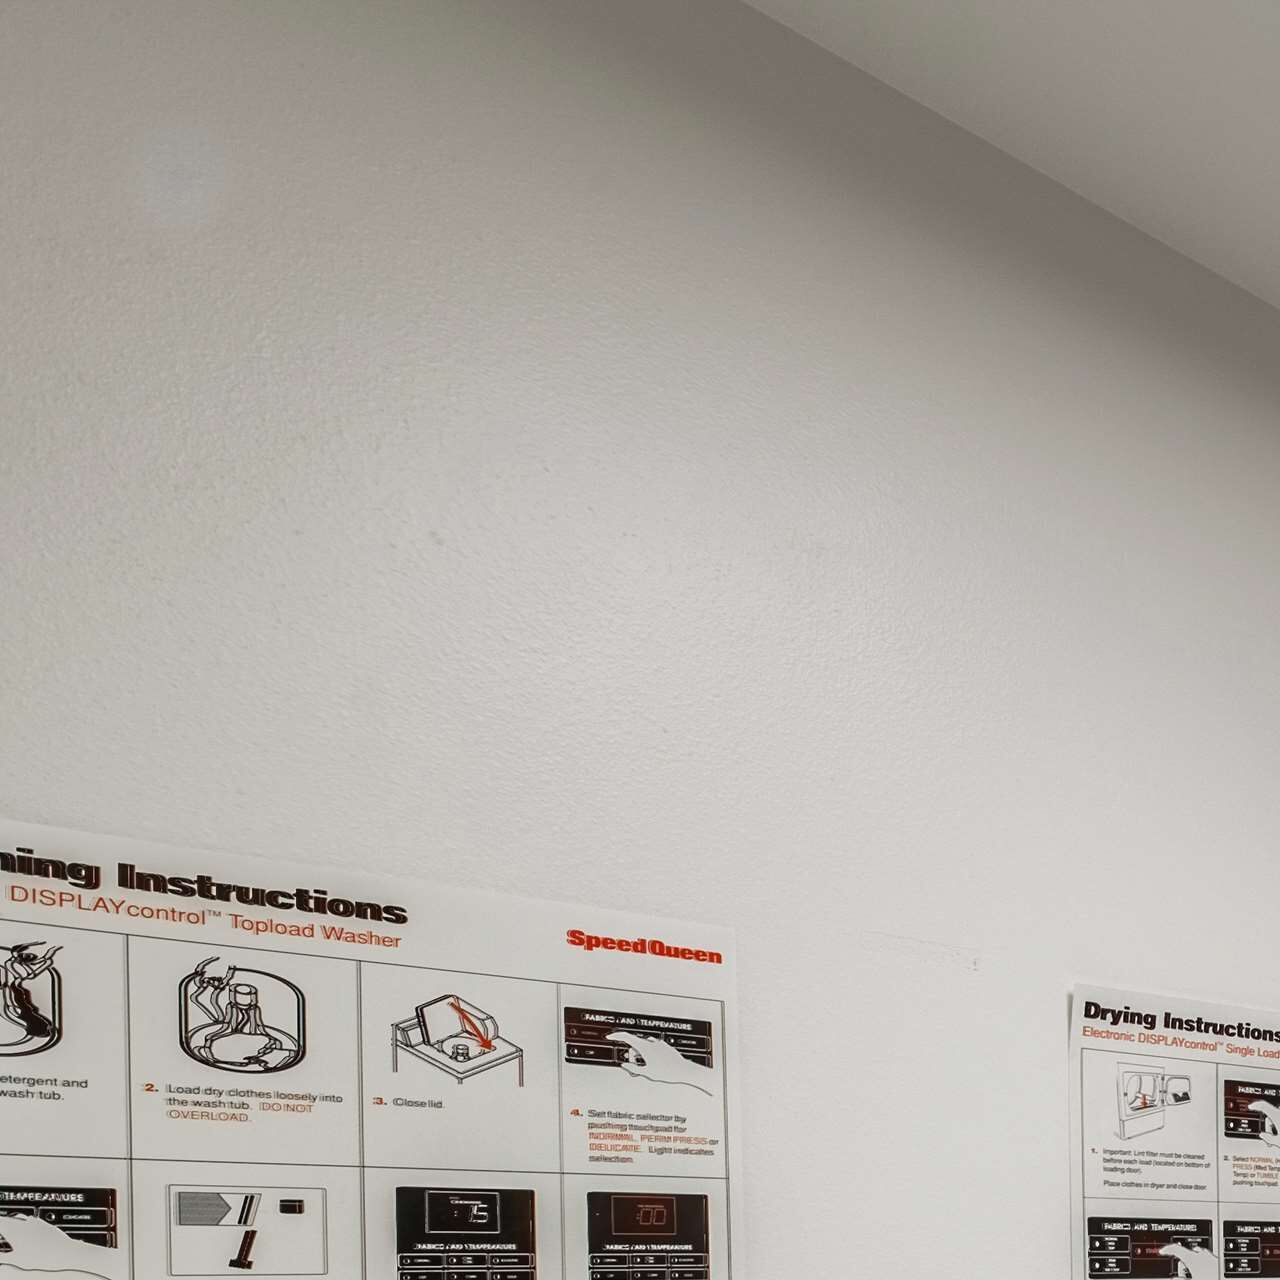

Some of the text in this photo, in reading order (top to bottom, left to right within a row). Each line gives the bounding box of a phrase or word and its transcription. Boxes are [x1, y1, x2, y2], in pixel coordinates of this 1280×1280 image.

[118, 862, 408, 925] Instructions
[228, 913, 314, 938] Topload
[321, 926, 402, 948] Washer
[567, 929, 722, 964] Speed Queen
[1084, 1001, 1157, 1030] Drying
[1082, 1026, 1135, 1042] Electronic
[1226, 1043, 1255, 1057] Single
[1257, 1048, 1280, 1059] Load
[62, 1079, 88, 1088] and
[39, 1090, 65, 1101] tub.
[143, 1083, 343, 1104] 2. Load dry clothes loosely into
[372, 1096, 388, 1106] 3.
[392, 1097, 427, 1108] Close
[165, 1097, 313, 1114] the wash tub. DO NOT
[570, 1108, 583, 1117] 4.
[166, 1109, 253, 1122] OVERLOAD.
